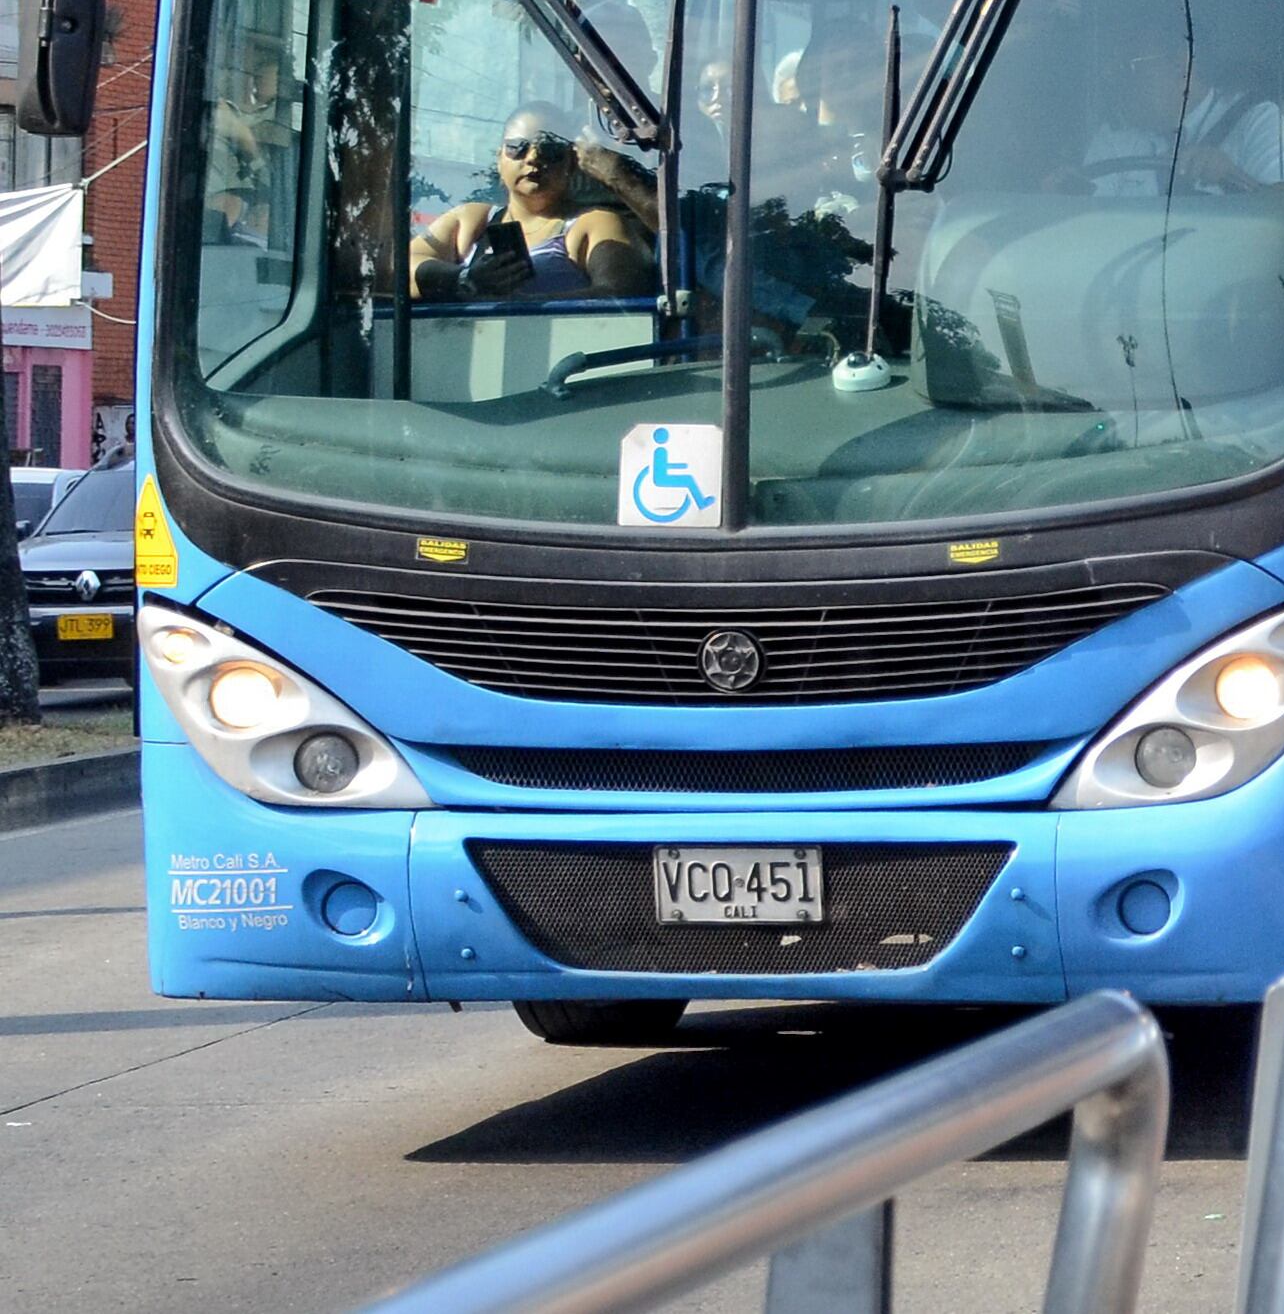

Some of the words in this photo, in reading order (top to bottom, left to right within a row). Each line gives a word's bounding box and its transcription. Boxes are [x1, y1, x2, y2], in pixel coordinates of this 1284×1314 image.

[59, 619, 83, 633] JTL
[87, 618, 111, 632] 399
[171, 854, 210, 870] Metro
[213, 853, 243, 869] Cali
[171, 877, 277, 905] MC21001
[746, 861, 815, 903] 451
[723, 905, 758, 919] CALI
[178, 914, 226, 930] Blanco
[228, 917, 238, 933] y
[241, 913, 289, 931] Negro
